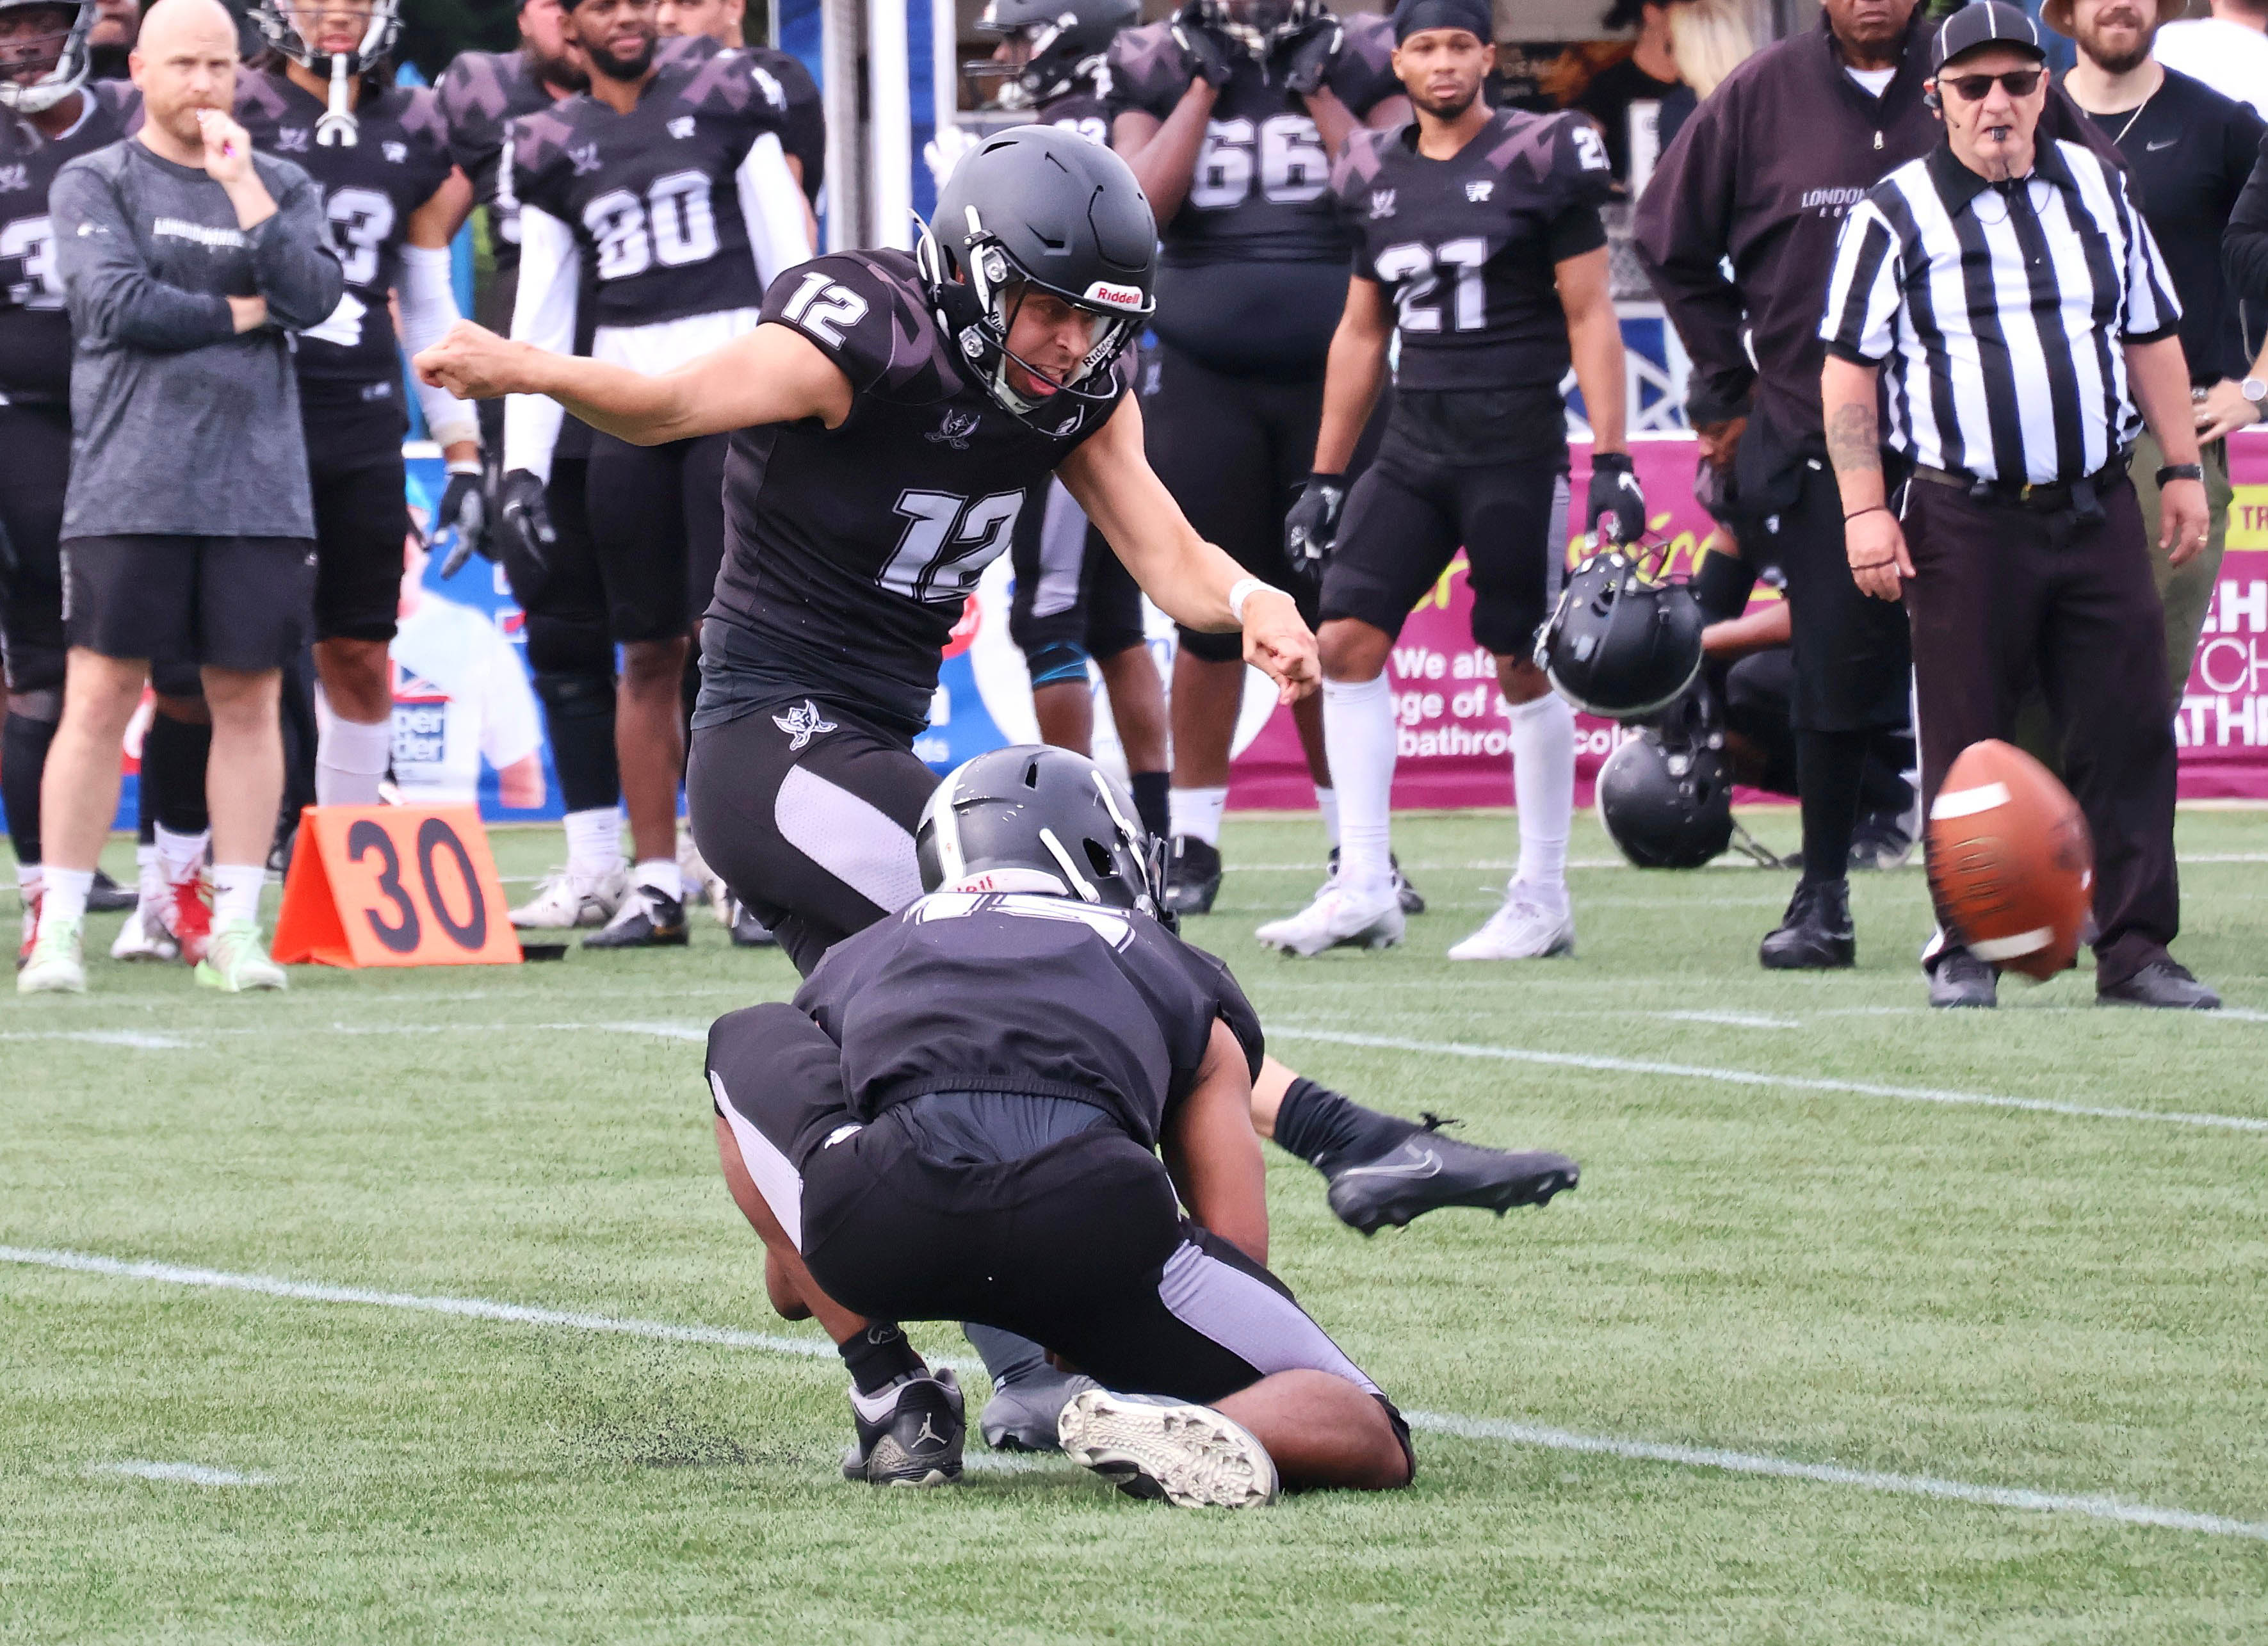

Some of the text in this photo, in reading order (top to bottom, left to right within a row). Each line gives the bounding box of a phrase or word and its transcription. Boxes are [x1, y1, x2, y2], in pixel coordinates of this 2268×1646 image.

[1190, 111, 1331, 211] 66
[0, 215, 67, 311] 3
[325, 185, 396, 287] 3
[583, 168, 720, 281] 80
[781, 271, 869, 351] 12
[1097, 287, 1140, 304] Riddell
[1375, 234, 1487, 333] 21
[874, 487, 1026, 603] 12
[1393, 646, 1498, 680] We als
[1452, 683, 1487, 718] of
[393, 712, 444, 740] per
[1397, 724, 1513, 756] bathro
[347, 817, 487, 954] 30
